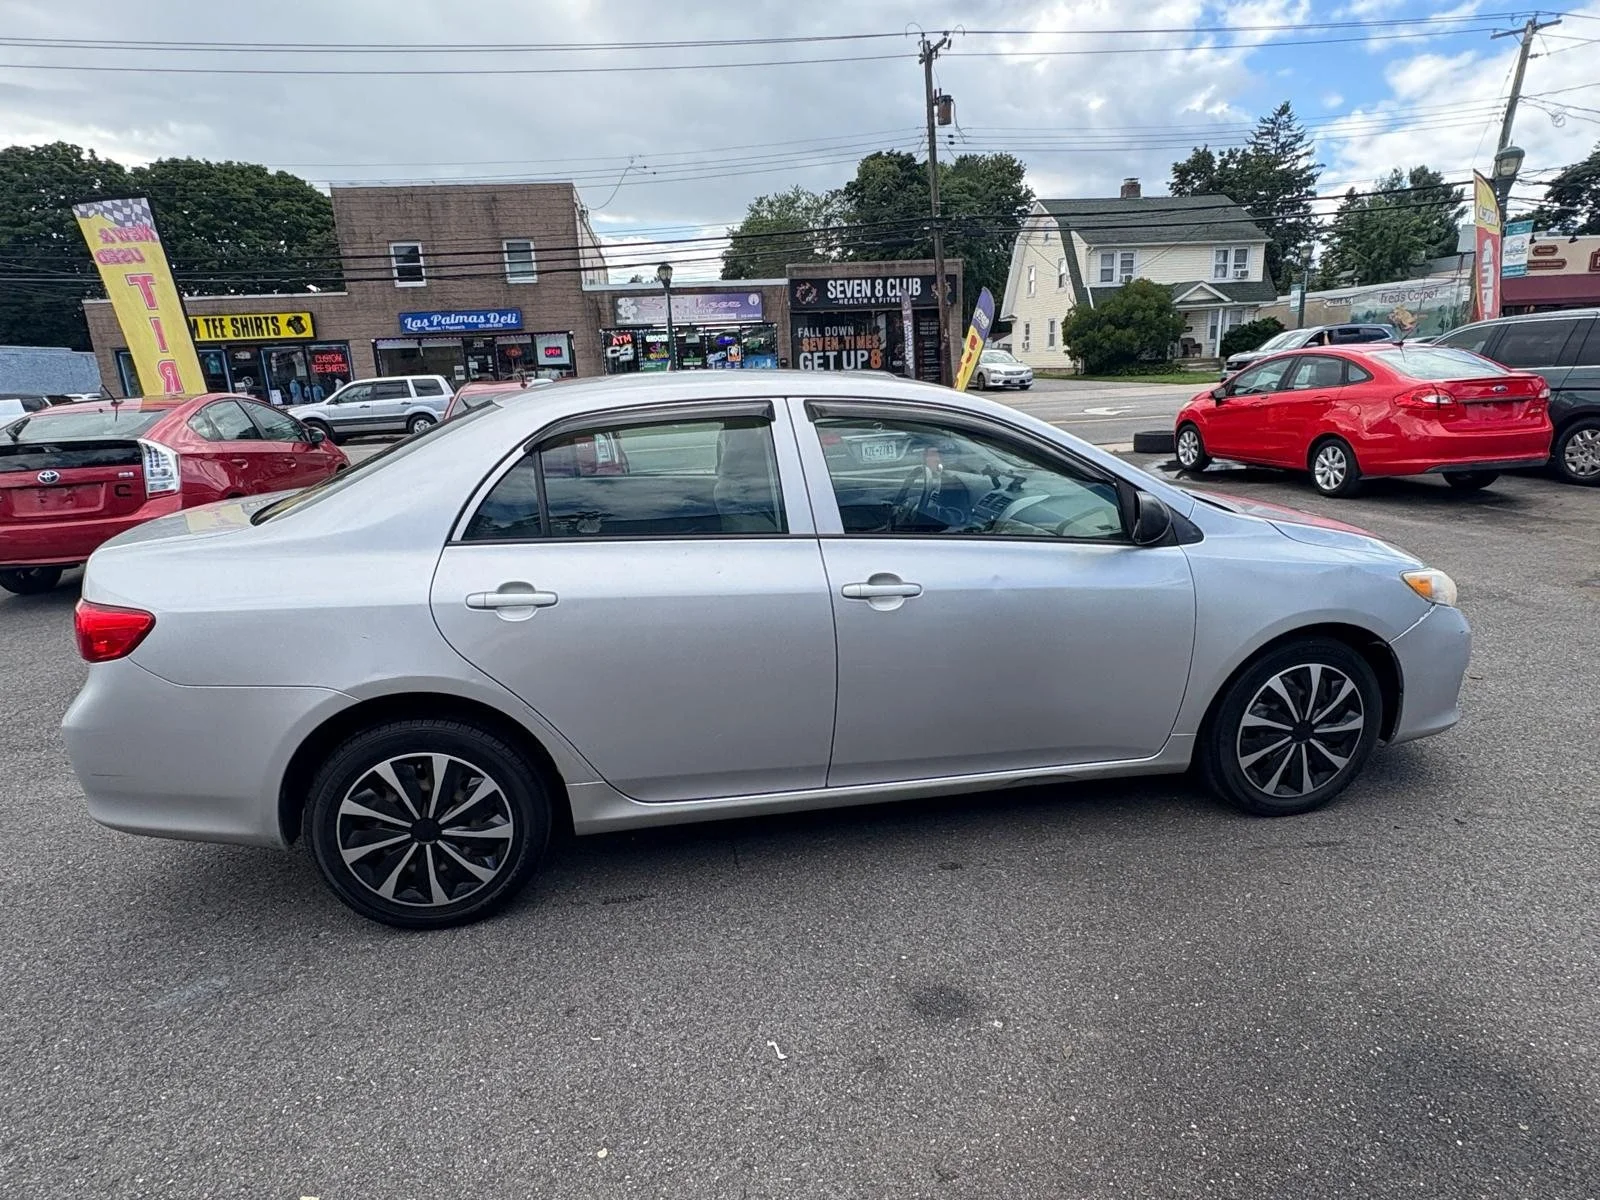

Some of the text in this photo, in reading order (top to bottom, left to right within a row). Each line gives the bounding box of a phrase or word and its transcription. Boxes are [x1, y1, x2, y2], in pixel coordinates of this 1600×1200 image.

[827, 278, 921, 299] SEVEN 8 CLUB
[204, 318, 227, 339] TEE
[230, 316, 281, 337] SHIRTS
[404, 317, 429, 331] Las
[430, 313, 485, 326] Palmas
[487, 312, 518, 324] Deli
[612, 334, 632, 346] ATM
[798, 326, 854, 337] FALL DOWN
[802, 334, 880, 351] SEVEN TIMES
[314, 354, 343, 363] CUSTOM
[799, 349, 882, 371] GET UP 8
[311, 363, 349, 373] TEE SHIRTS
